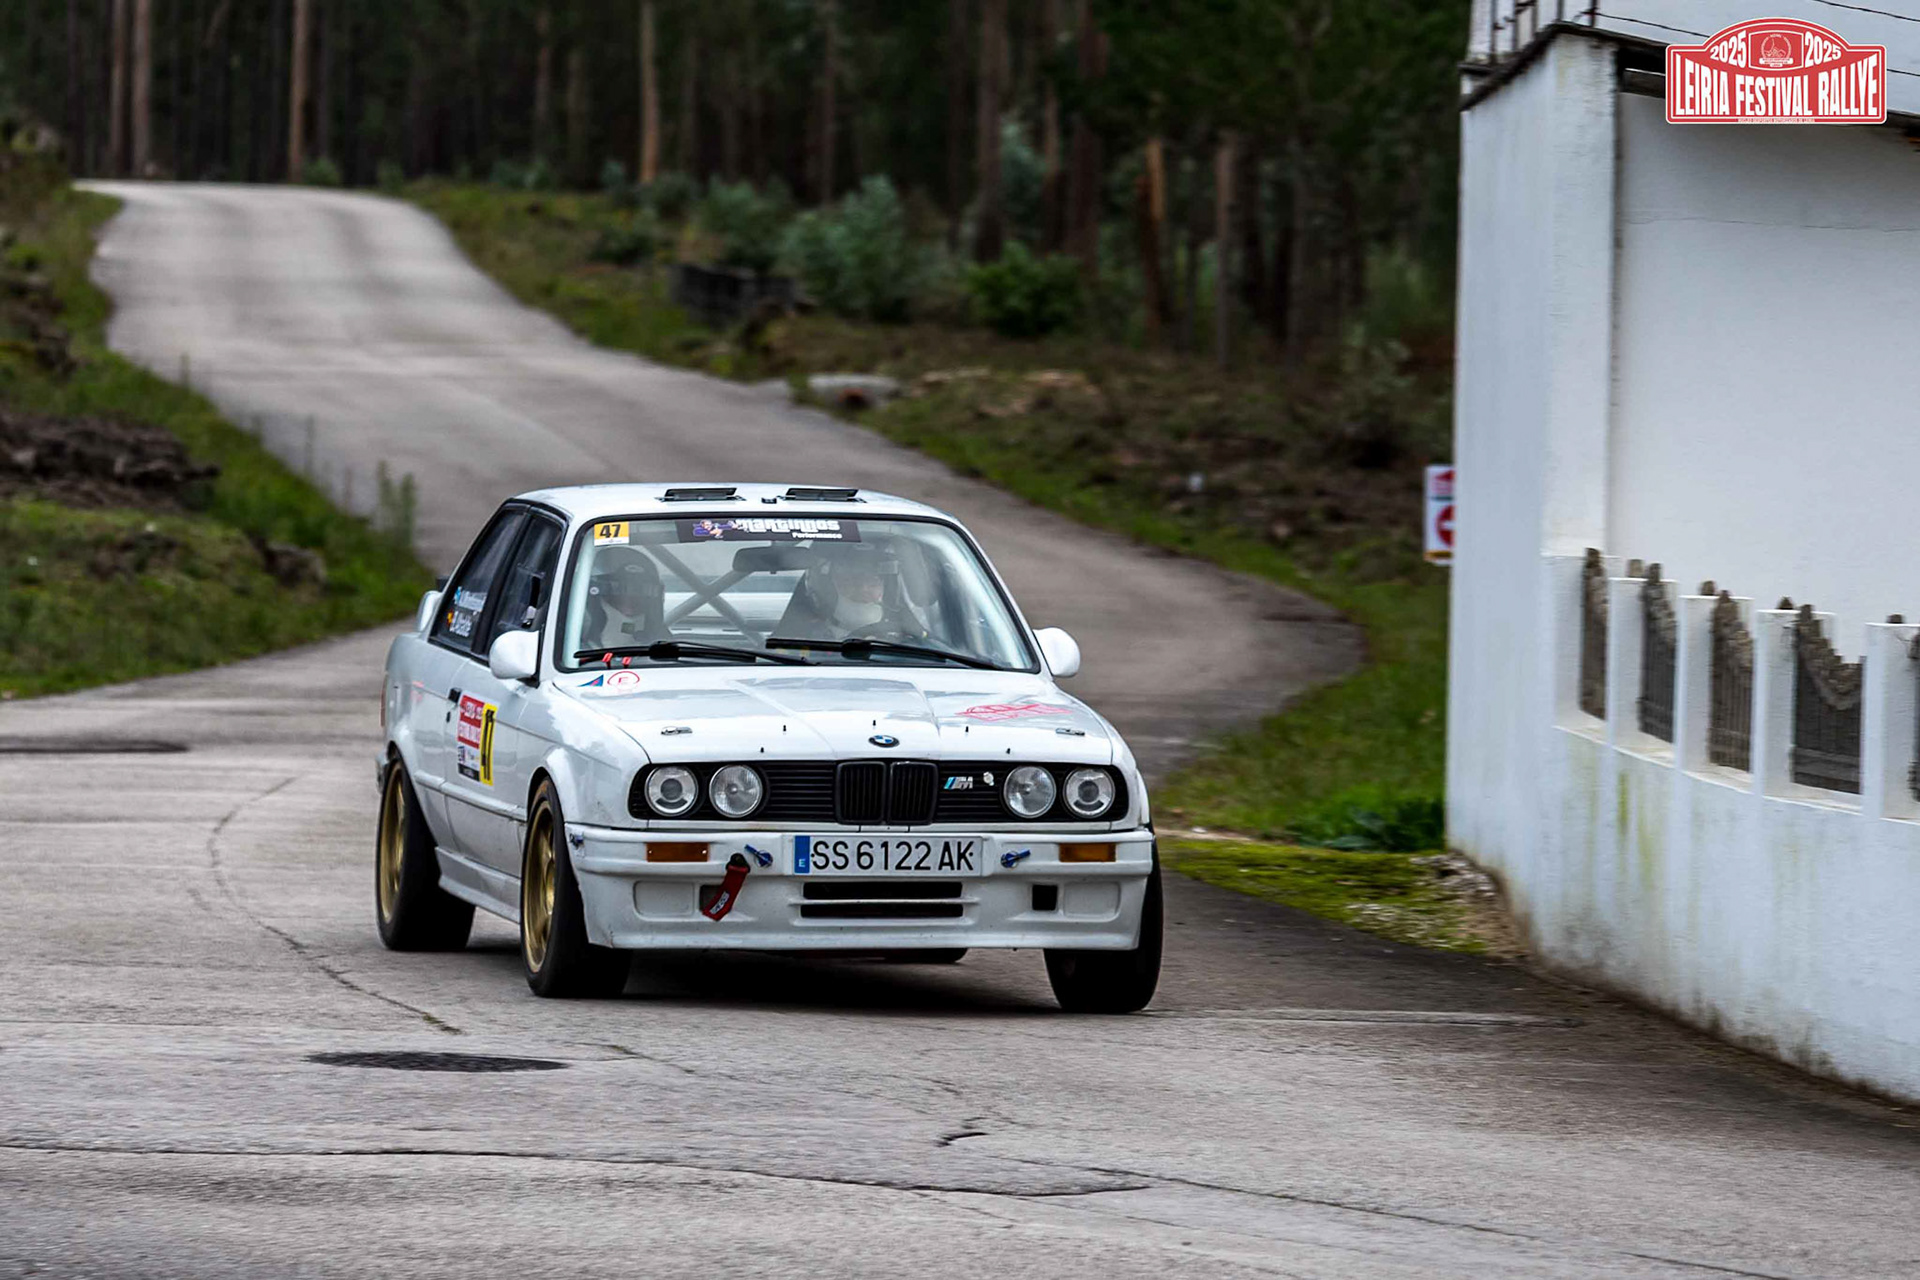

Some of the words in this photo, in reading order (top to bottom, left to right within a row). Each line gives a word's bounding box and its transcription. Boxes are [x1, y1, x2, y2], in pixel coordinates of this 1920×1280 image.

[600, 524, 621, 538] 47
[812, 841, 849, 870] SS
[856, 841, 931, 870] 6122
[937, 841, 975, 870] AK
[798, 858, 806, 868] E
